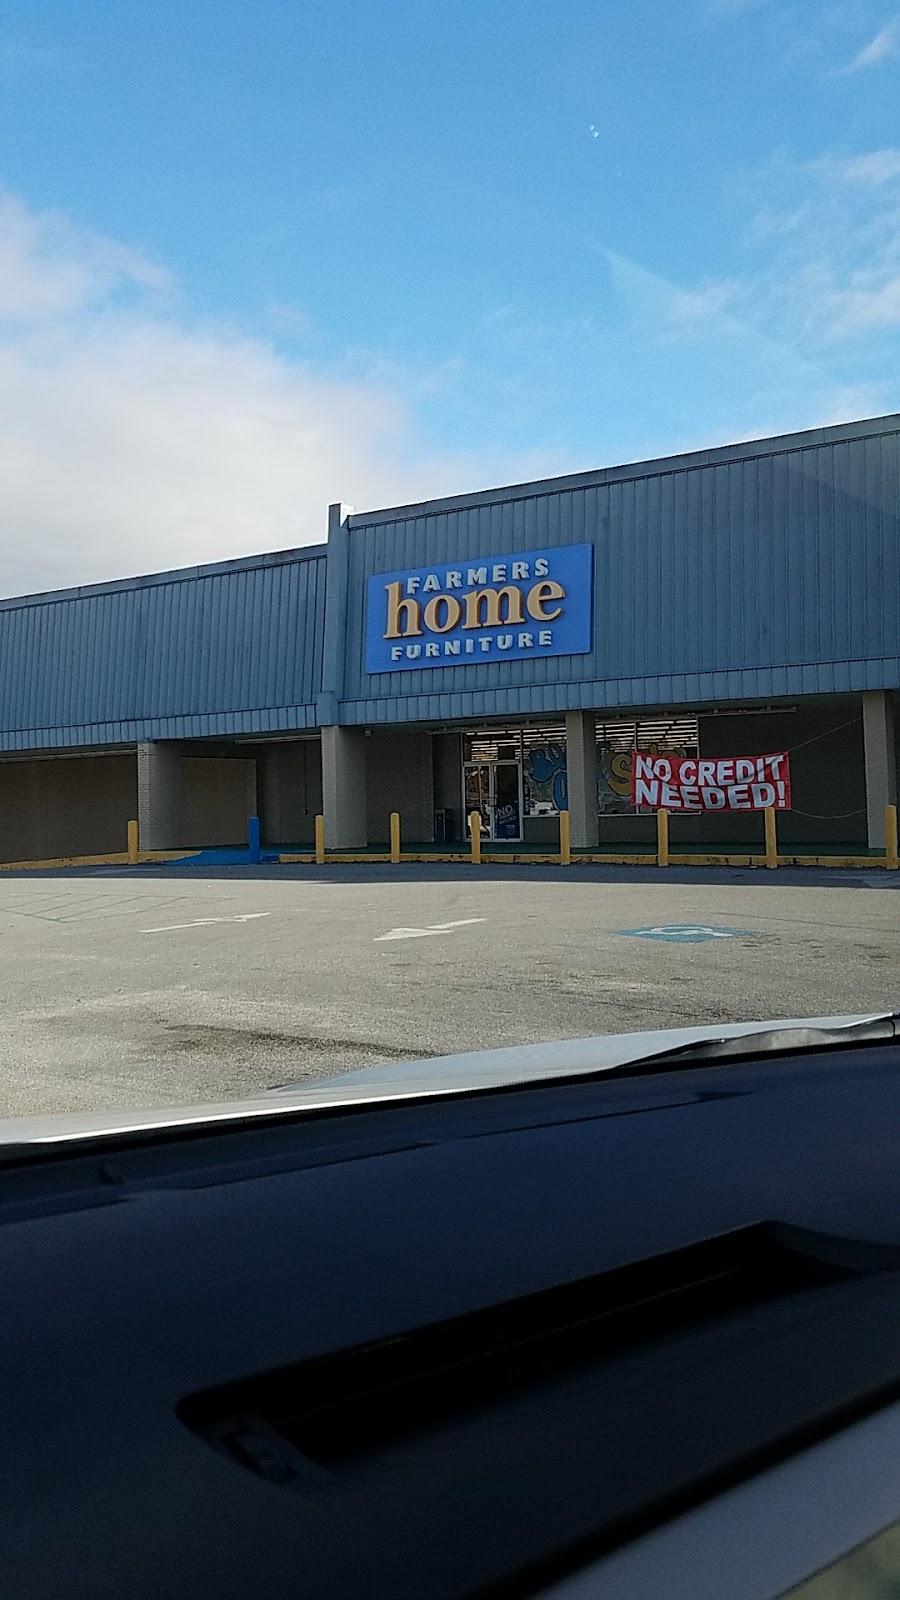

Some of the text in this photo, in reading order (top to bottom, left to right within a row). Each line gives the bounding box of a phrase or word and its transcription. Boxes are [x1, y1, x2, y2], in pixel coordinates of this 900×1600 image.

[407, 558, 549, 594] FARMERS
[383, 580, 566, 639] home
[391, 630, 552, 661] FURNITURE
[636, 755, 672, 783] NO
[679, 755, 784, 786] CREDIT
[635, 779, 785, 810] NEEDED!
[497, 804, 514, 817] NO
